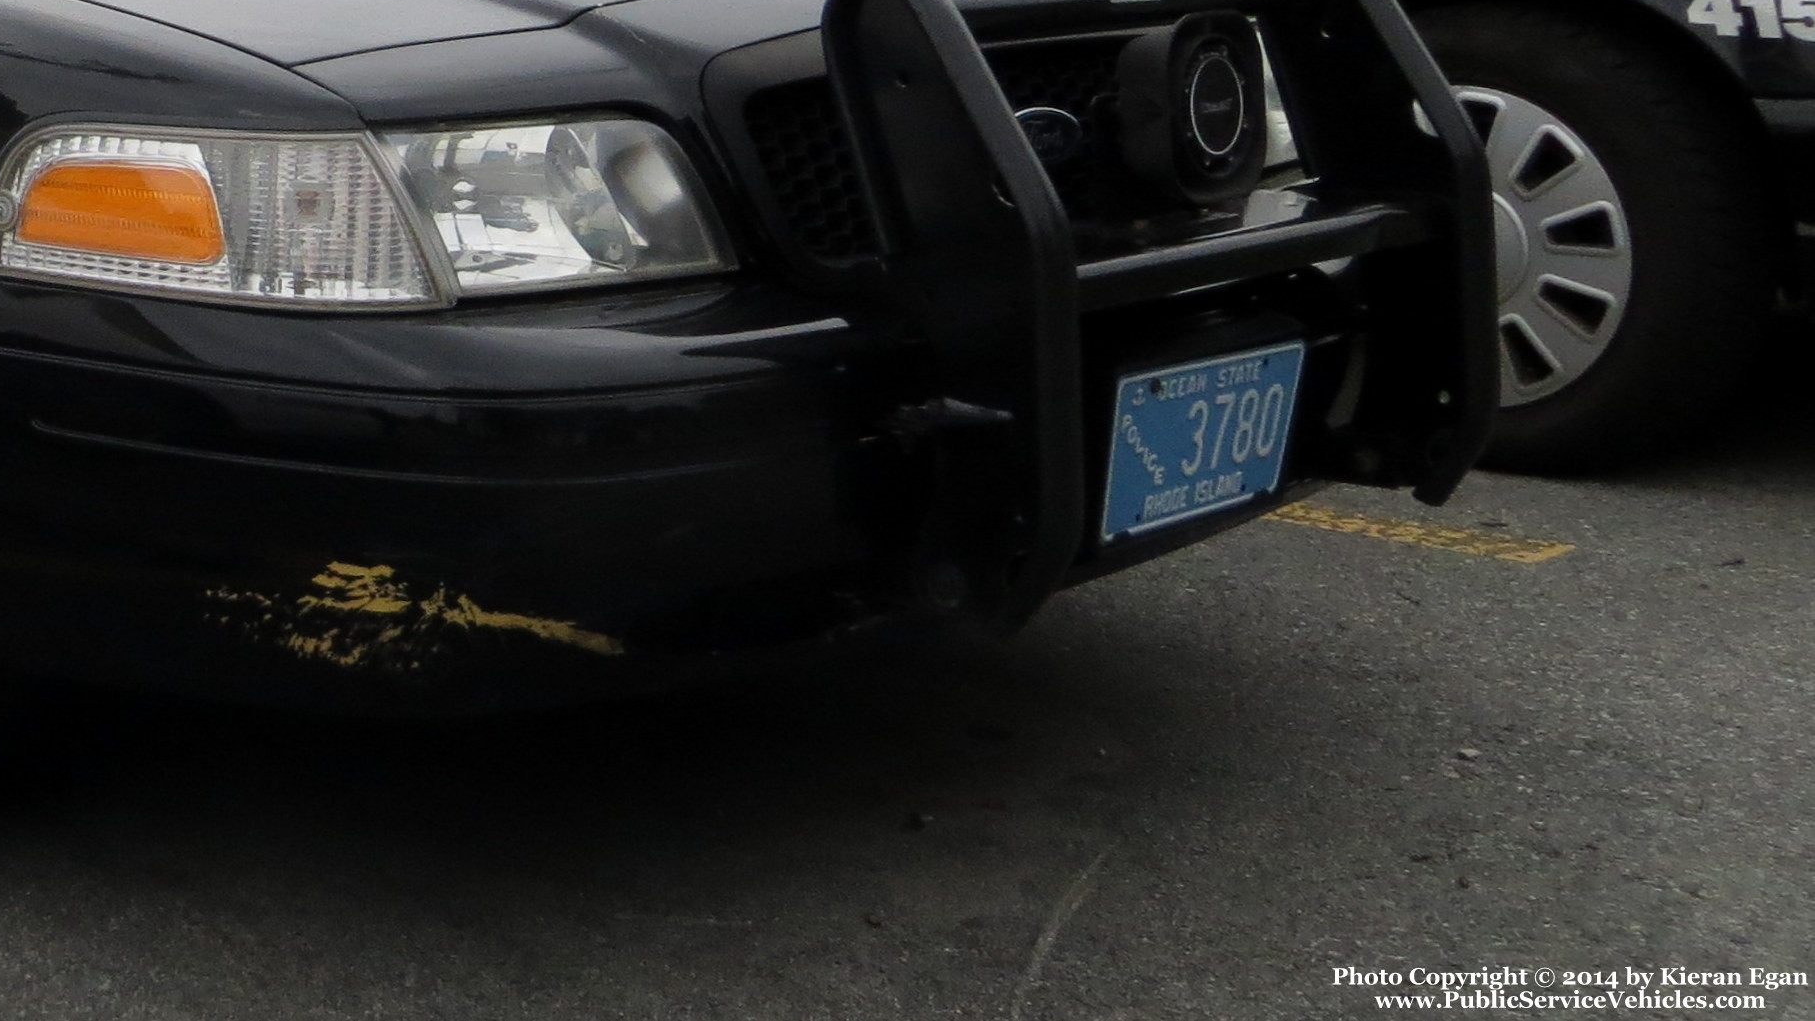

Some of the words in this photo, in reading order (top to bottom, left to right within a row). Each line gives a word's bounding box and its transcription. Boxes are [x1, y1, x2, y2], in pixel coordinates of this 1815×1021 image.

[1158, 374, 1208, 401] OCEAN
[1216, 361, 1263, 388] STATE
[1181, 383, 1283, 476] 3780
[1122, 414, 1166, 485] POLICE
[1143, 484, 1189, 521] RHODE
[1194, 471, 1243, 504] ISLAND
